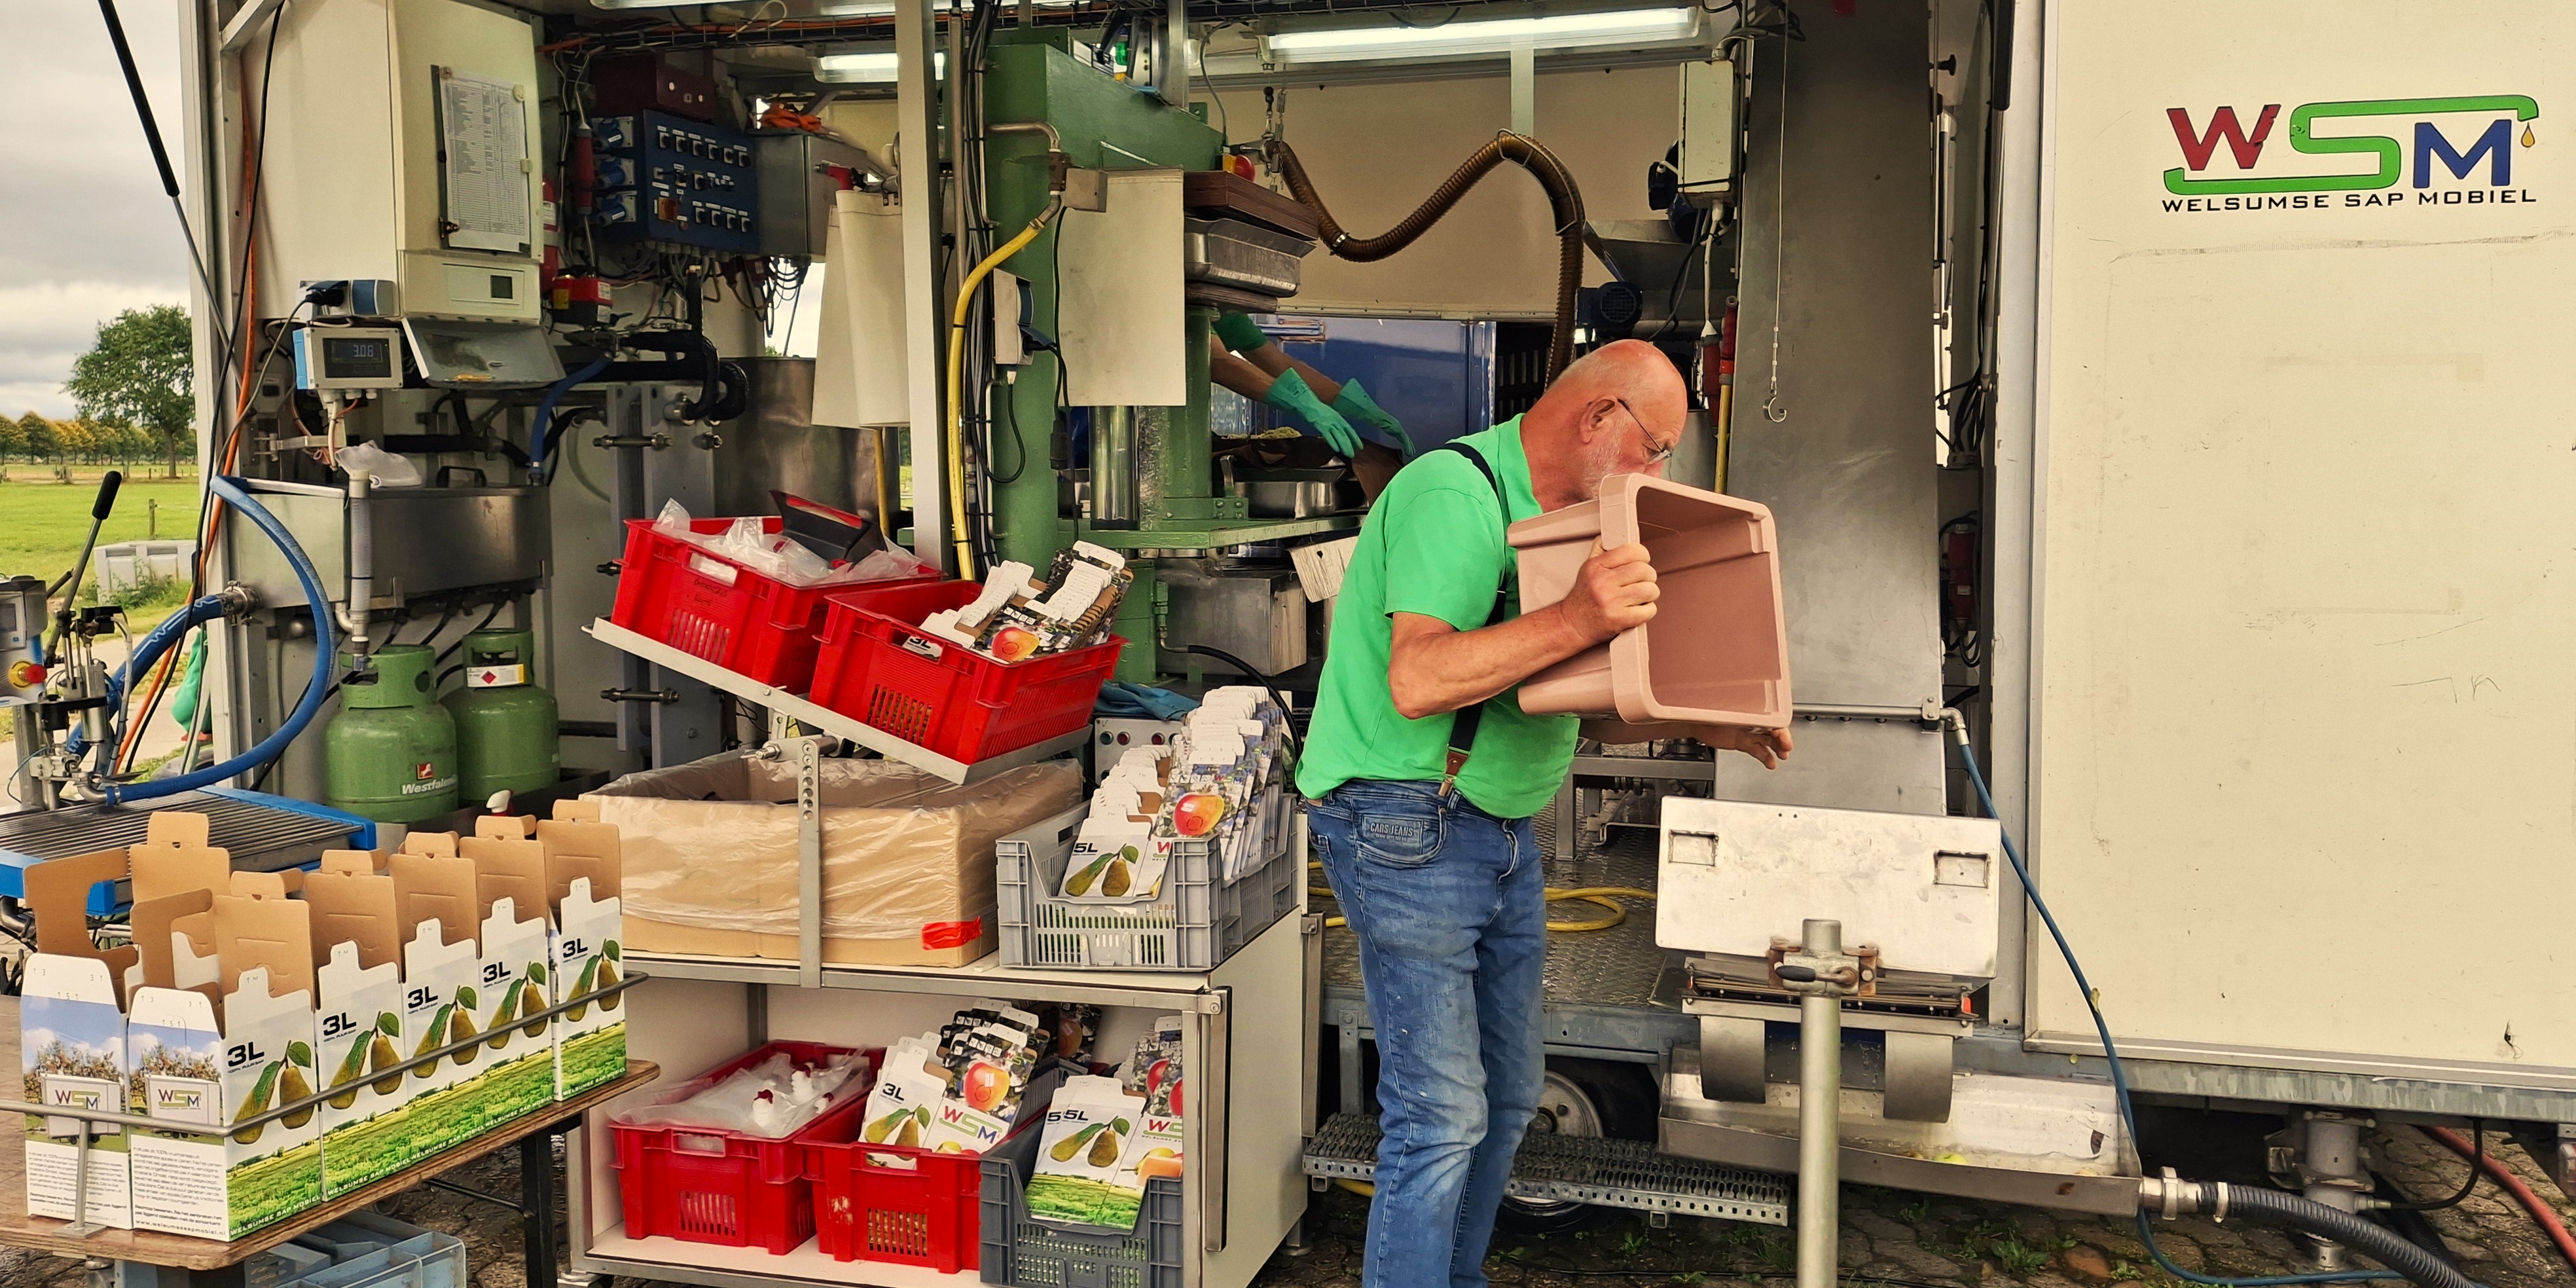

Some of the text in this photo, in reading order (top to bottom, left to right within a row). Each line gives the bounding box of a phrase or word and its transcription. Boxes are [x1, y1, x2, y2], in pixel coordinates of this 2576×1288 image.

[2164, 94, 2539, 194] WSM
[2162, 189, 2537, 213] WELSUMSE SAP MOBIEL
[1370, 822, 1413, 837] CARS JEANS
[1073, 842, 1098, 853] 5L
[562, 938, 589, 958] 3L
[483, 961, 511, 983] 3L
[408, 986, 438, 1008] 3L
[323, 1012, 356, 1036] 3L
[227, 1041, 265, 1067] 3L
[158, 1089, 202, 1107] WSM
[882, 1082, 904, 1101] 3L
[939, 1105, 1003, 1144] WSM
[1063, 1110, 1089, 1121] 5L
[327, 1158, 411, 1196] WELSUMSE SAP MOBIEL
[230, 1195, 321, 1236] WELSUMSE SAP MOBIEL
